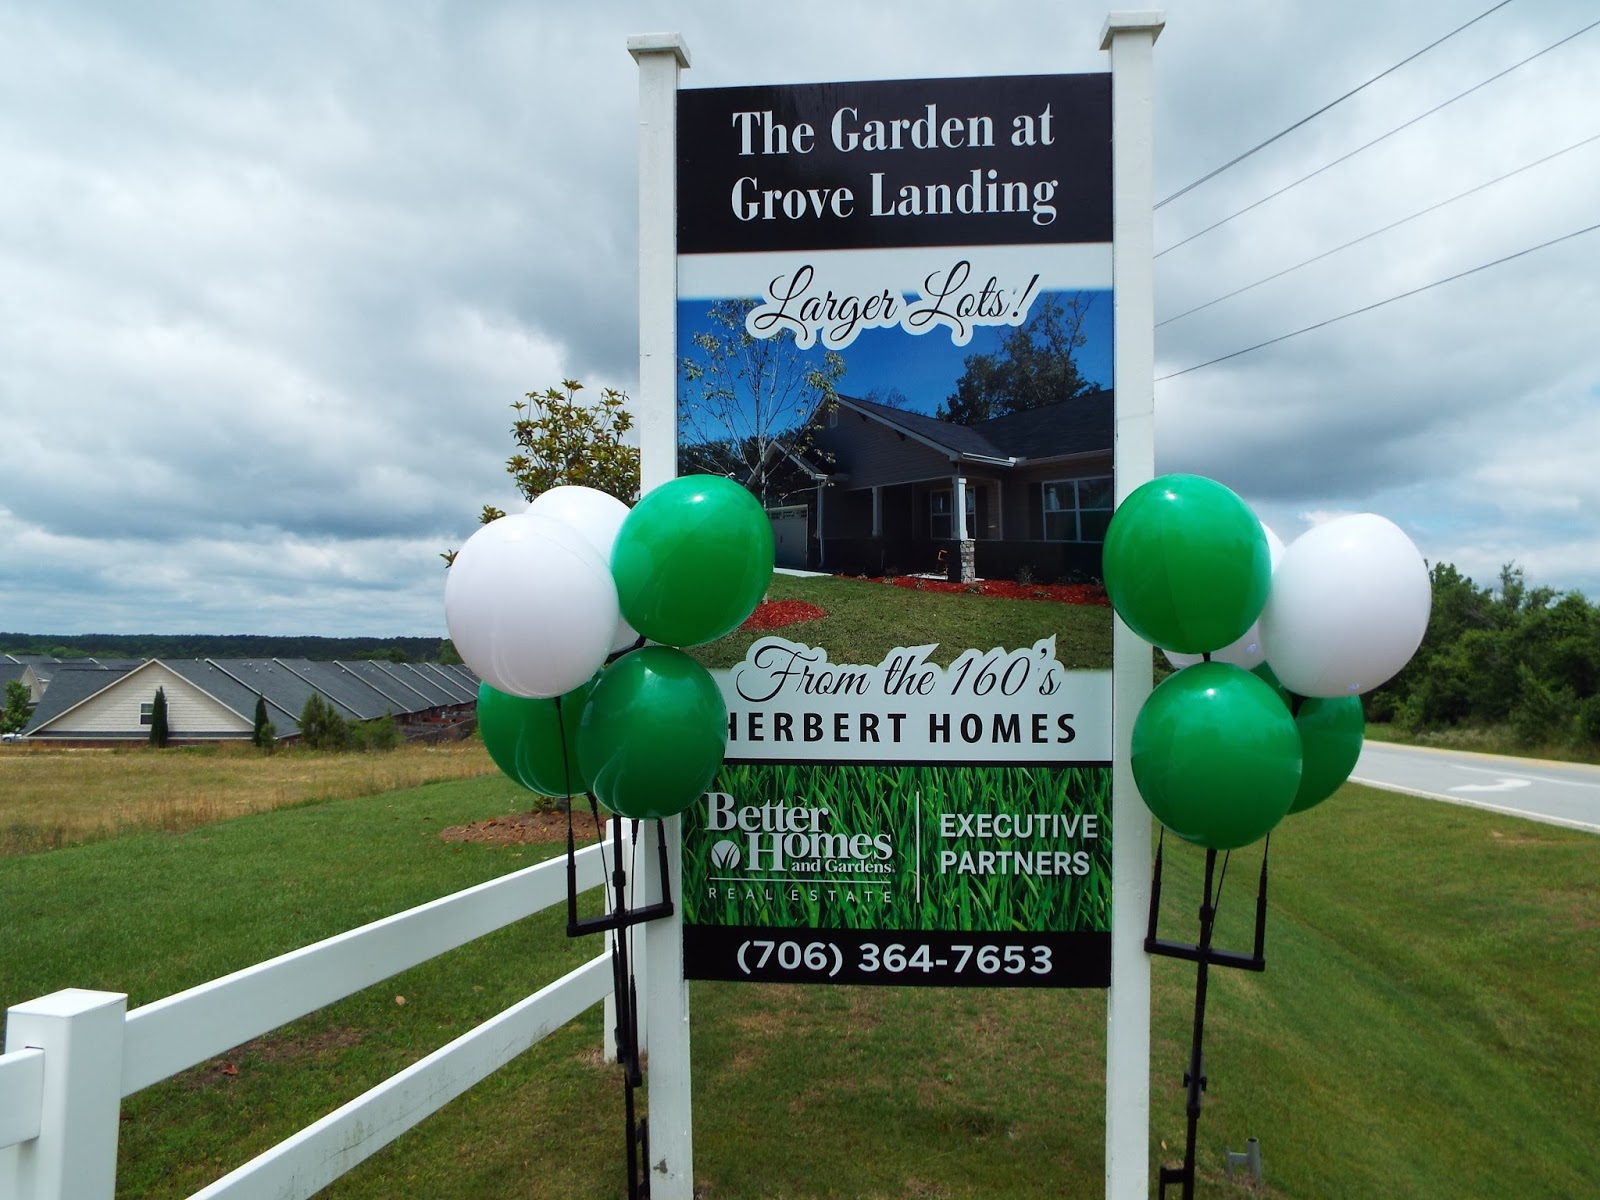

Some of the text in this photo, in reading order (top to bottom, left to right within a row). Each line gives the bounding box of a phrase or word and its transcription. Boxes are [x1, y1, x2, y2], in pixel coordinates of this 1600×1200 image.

[732, 103, 1055, 155] The Garden at
[731, 169, 1059, 226] Grove Landing
[754, 260, 1040, 342] Larger Lots!
[735, 644, 870, 702] From
[884, 654, 935, 696] the
[929, 713, 1077, 744] HOMES
[704, 792, 829, 833] Better
[940, 813, 1098, 840] EXECUTIVE
[744, 831, 893, 872] Homes
[791, 859, 822, 873] and
[940, 851, 1090, 876] PARTNERS
[709, 887, 892, 904] REAL ESTATE
[737, 940, 1053, 977] (706) 364-7653
